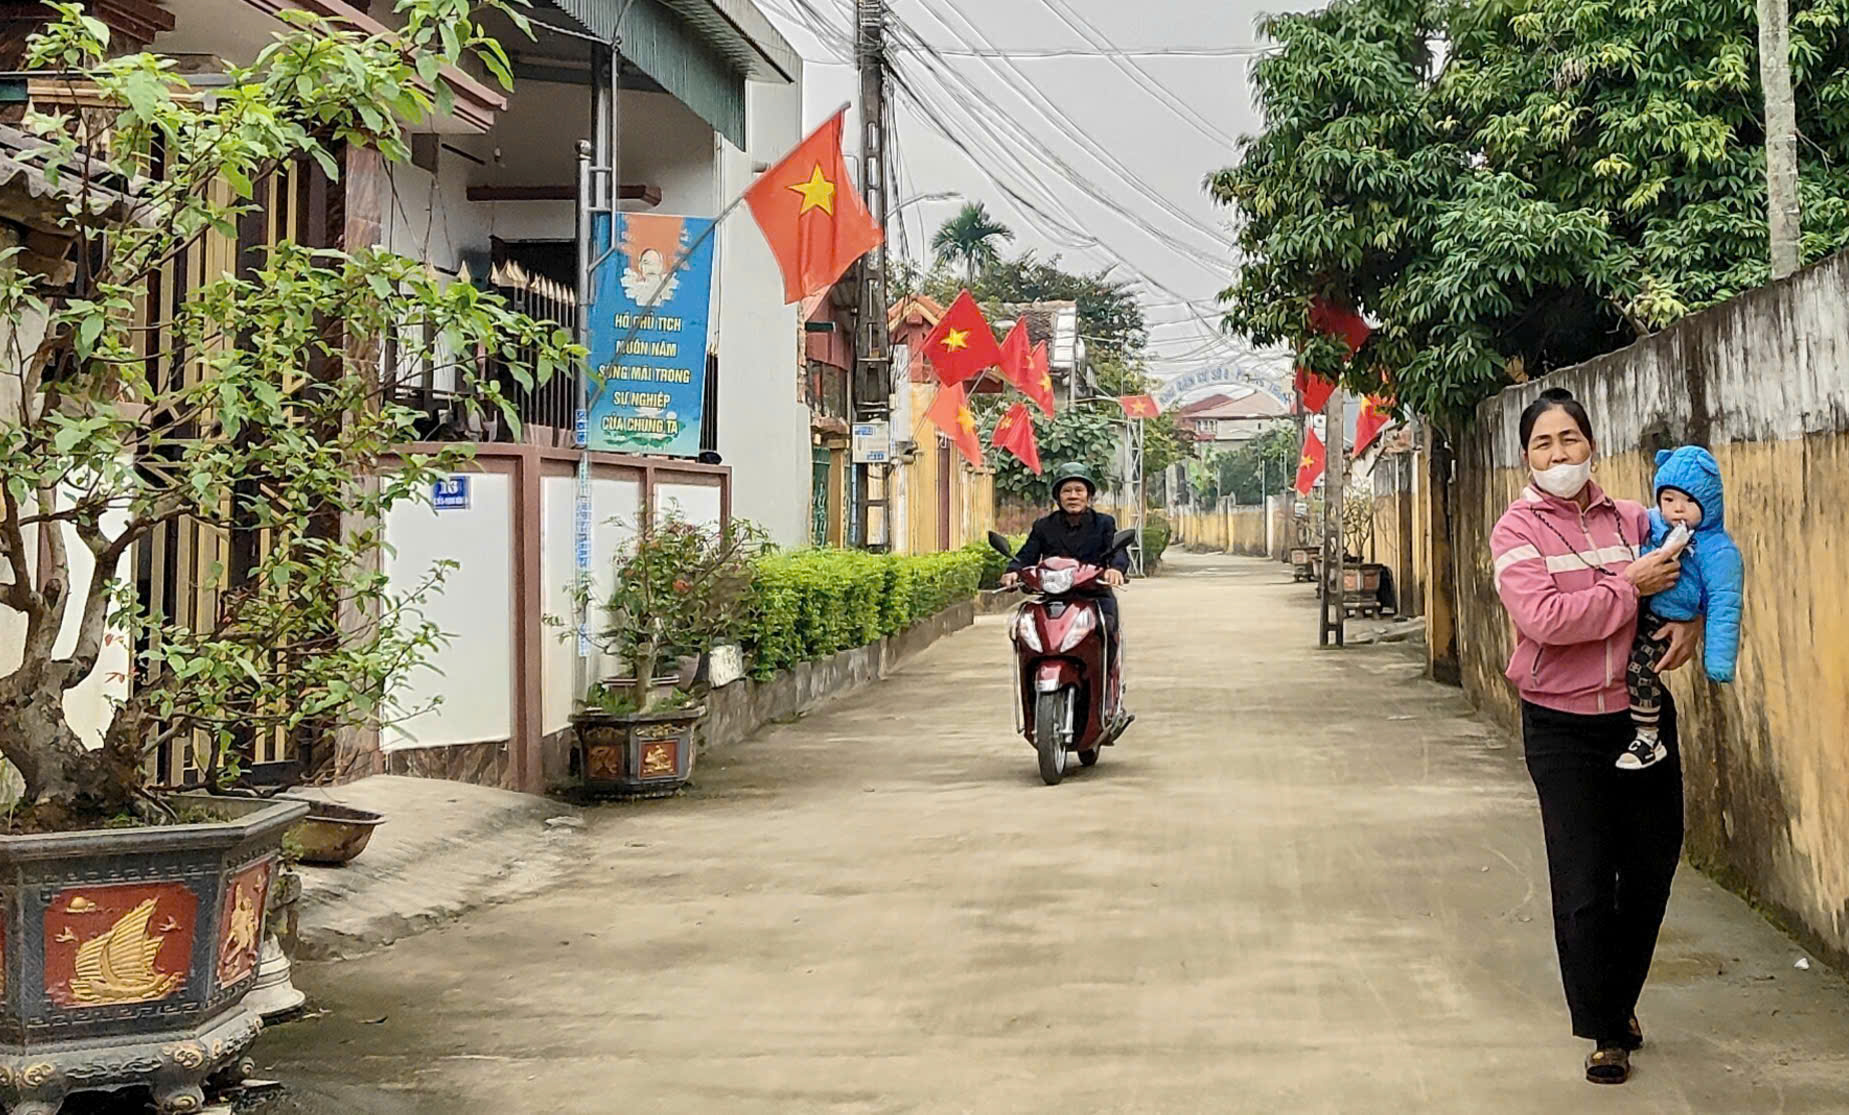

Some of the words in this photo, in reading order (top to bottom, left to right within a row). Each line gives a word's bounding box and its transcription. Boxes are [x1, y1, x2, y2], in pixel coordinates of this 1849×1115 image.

[658, 316, 682, 334] TỊCH
[656, 367, 691, 384] TRONG
[613, 391, 630, 409] SỰ
[631, 391, 671, 410] NGHIỆP
[602, 412, 625, 431] CỦA
[627, 415, 664, 434] CHÚNG
[665, 419, 679, 436] TA
